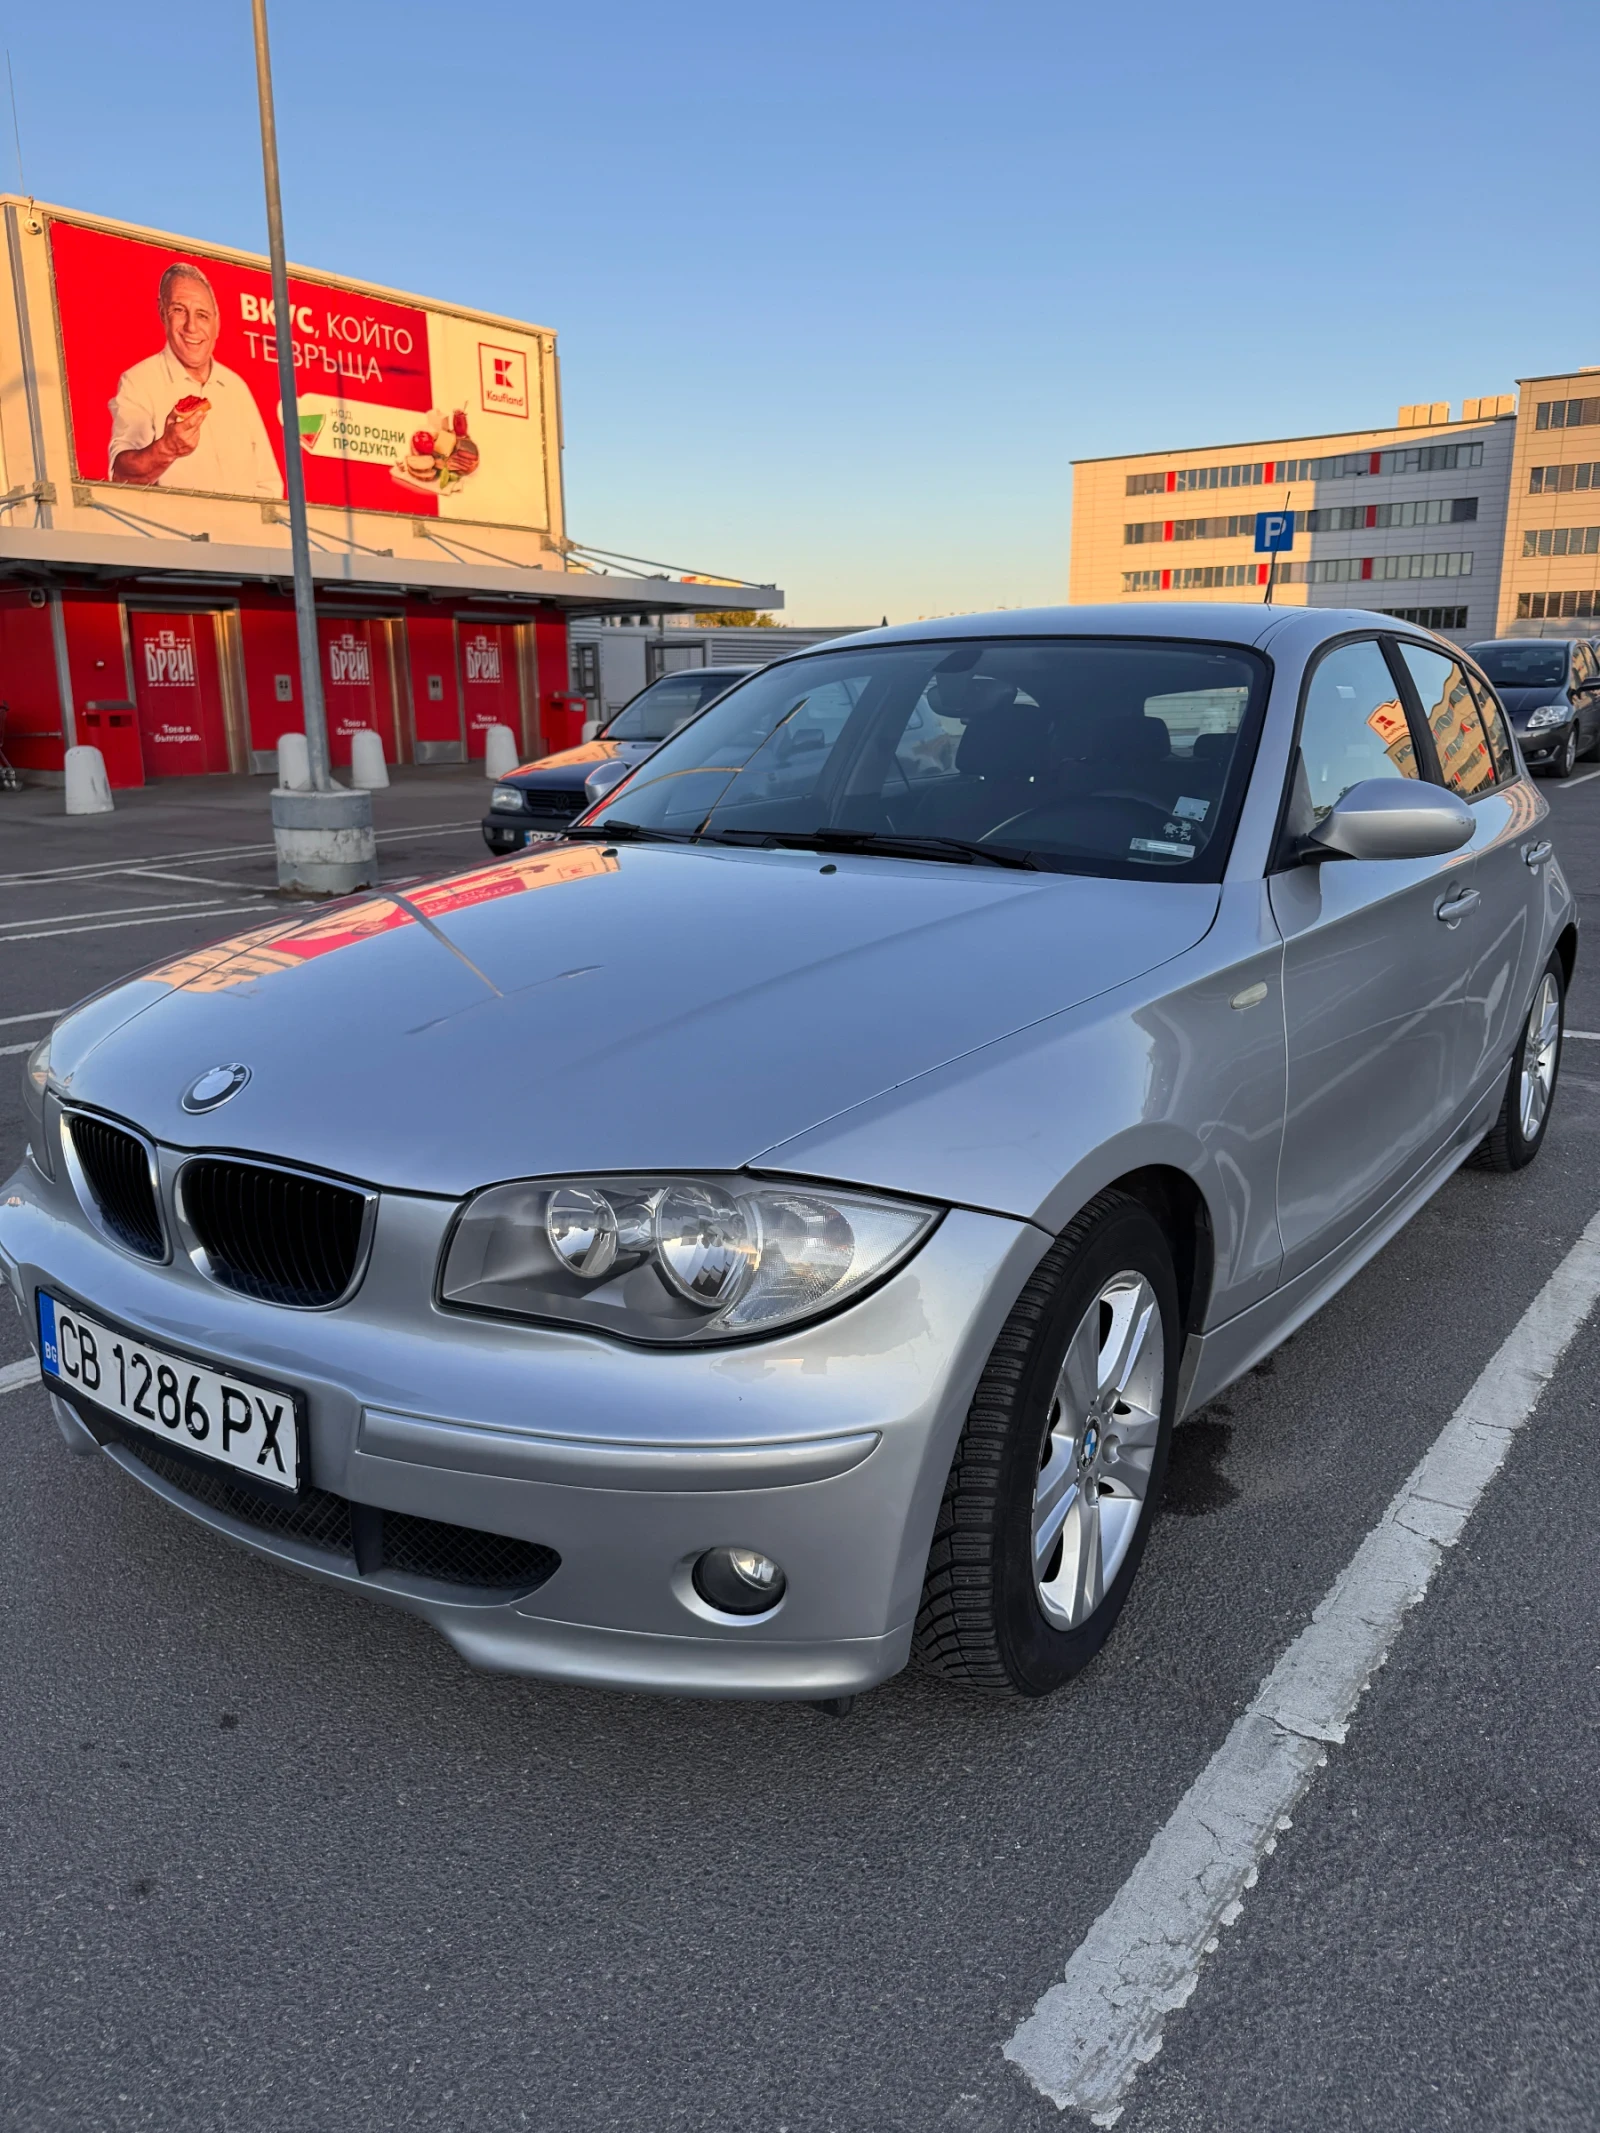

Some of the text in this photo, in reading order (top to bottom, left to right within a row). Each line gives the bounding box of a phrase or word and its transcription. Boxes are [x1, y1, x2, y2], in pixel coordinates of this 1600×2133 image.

[326, 312, 413, 355] КОЙТО
[243, 331, 383, 384] ТЕ ВРЪЩА
[486, 390, 524, 407] Kaufland
[332, 421, 406, 444] 6000 РОДНИ
[333, 437, 398, 458] ПРОДУКТА
[1264, 516, 1287, 548] P
[144, 642, 195, 682] Брей!
[44, 1341, 58, 1363] BG
[59, 1315, 287, 1474] CB 1286 PX
